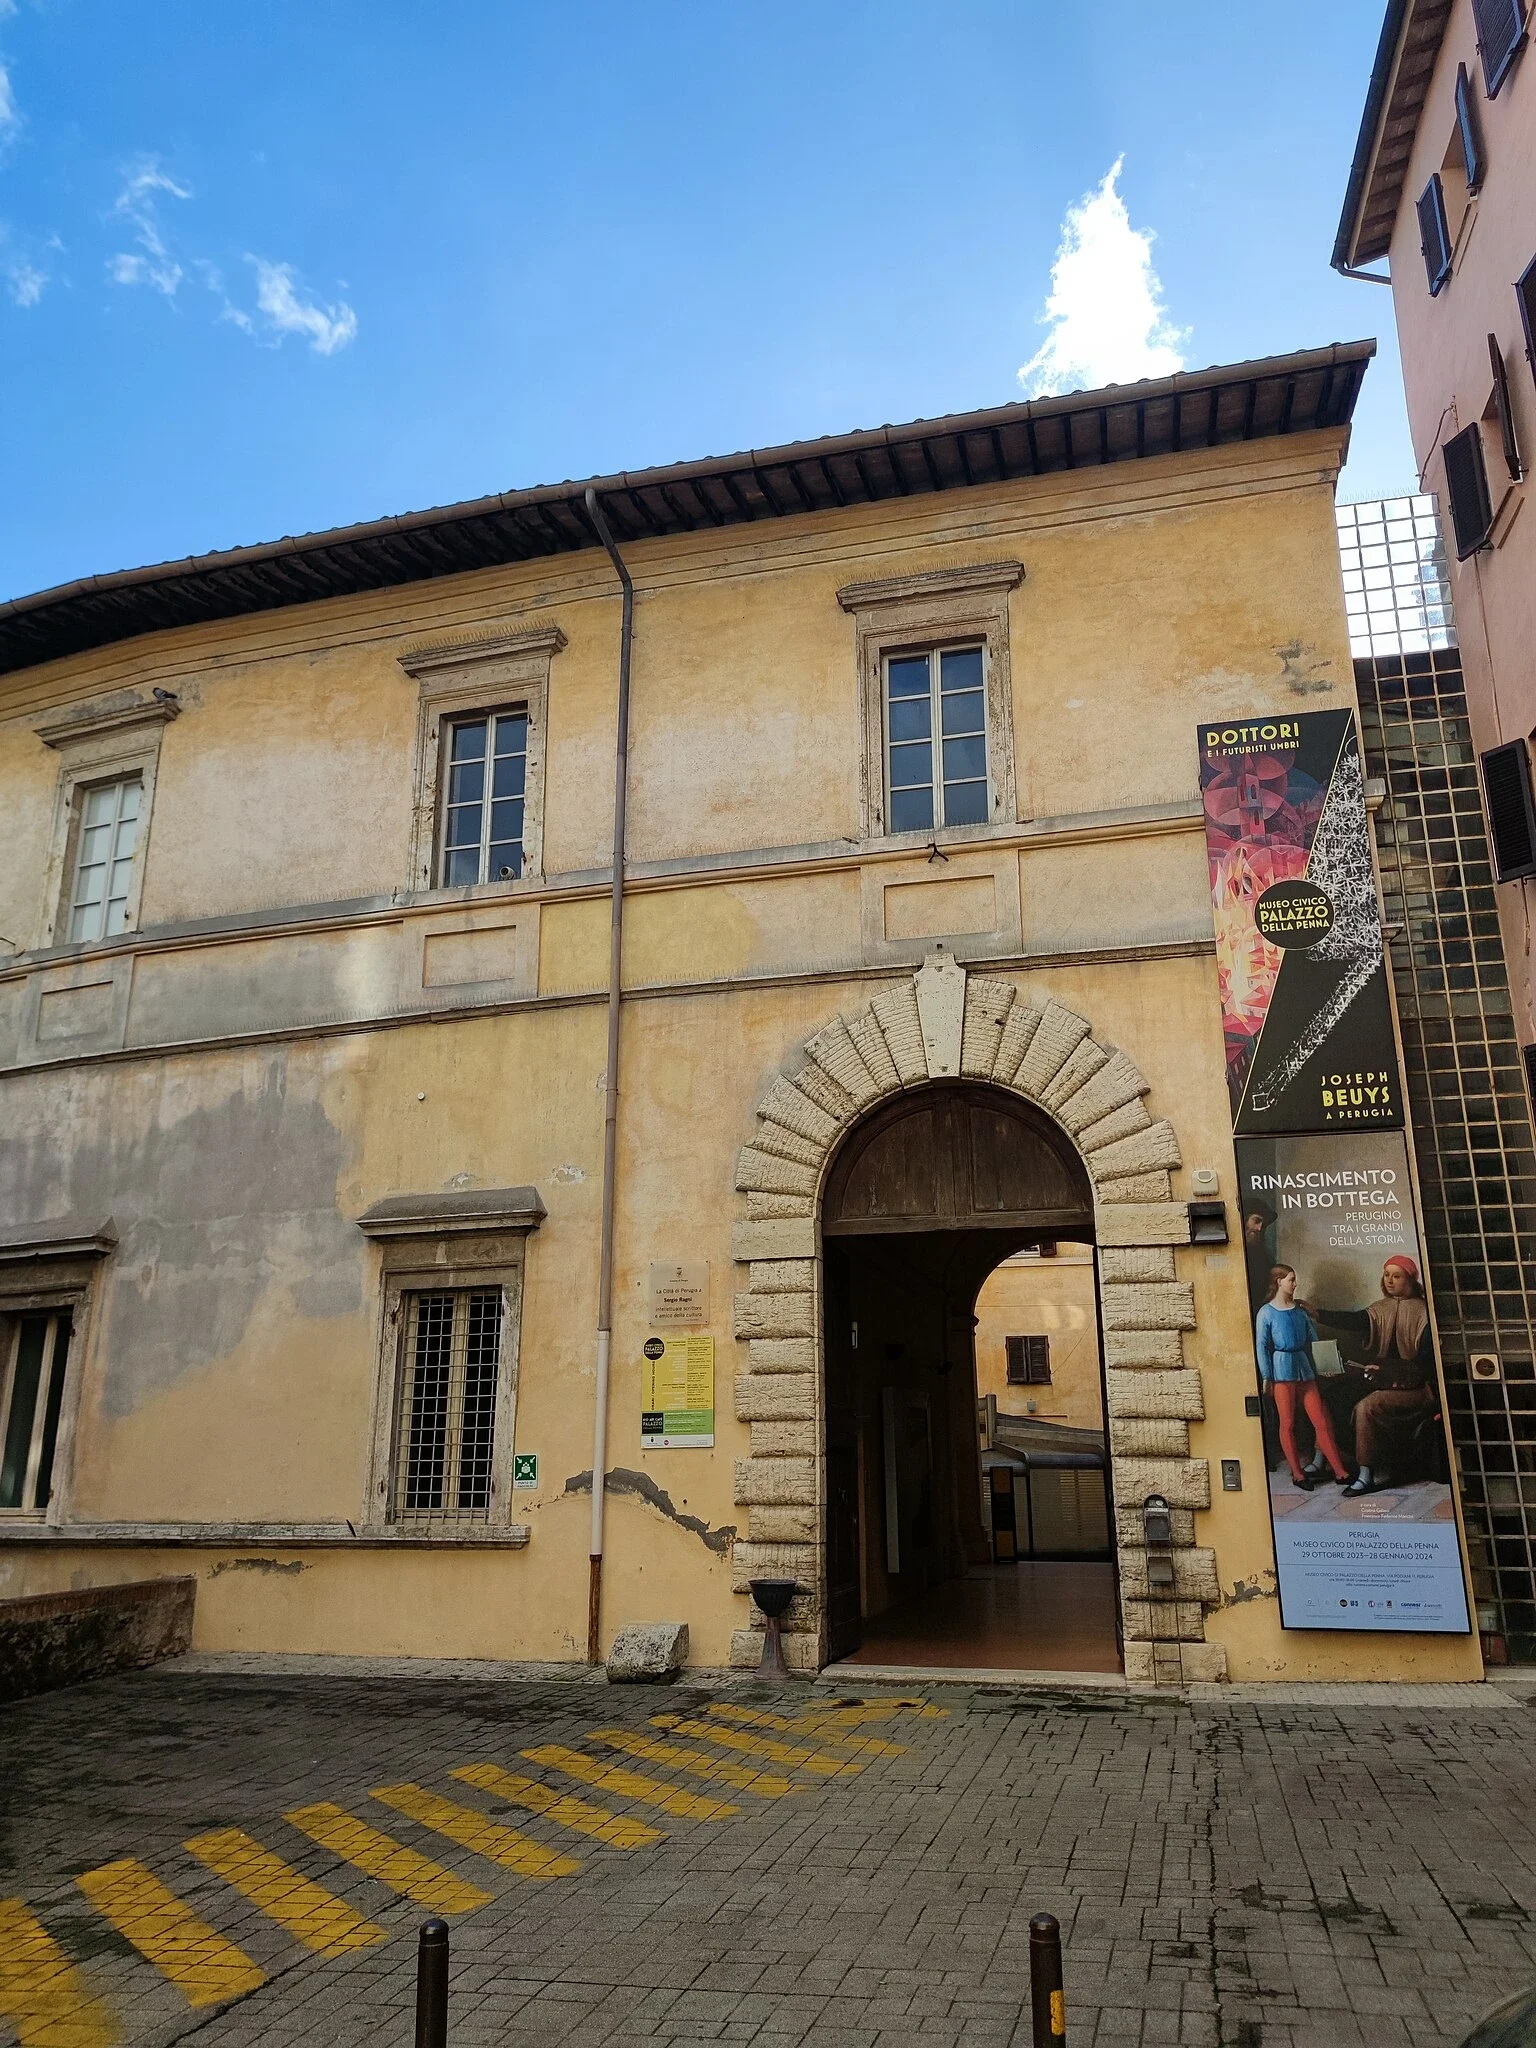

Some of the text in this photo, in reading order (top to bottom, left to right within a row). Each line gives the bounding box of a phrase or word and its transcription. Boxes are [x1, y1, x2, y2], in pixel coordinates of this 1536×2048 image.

[1206, 722, 1299, 747] DOTTORI
[1207, 750, 1212, 758] E
[1222, 744, 1267, 756] FUTURISTI
[1270, 740, 1299, 751] UMBRI
[1259, 896, 1326, 910] MUSEO CIVICO
[1260, 905, 1329, 923] PALAZZO
[1261, 919, 1330, 933] DELLA PENNA
[1321, 1071, 1388, 1087] JOSEPH
[1322, 1086, 1390, 1107] BEUYS
[1326, 1108, 1393, 1120] A PERUGIA
[1250, 1169, 1396, 1190] RINASCIMENTO
[1282, 1190, 1399, 1209] IN BOTTEGA
[1345, 1210, 1402, 1222] PERUGINO
[1332, 1225, 1353, 1234] TRA
[1361, 1222, 1403, 1233] GRANDI
[1329, 1234, 1404, 1246] DELLA STORIA
[1312, 1551, 1345, 1559] OTTOBRE
